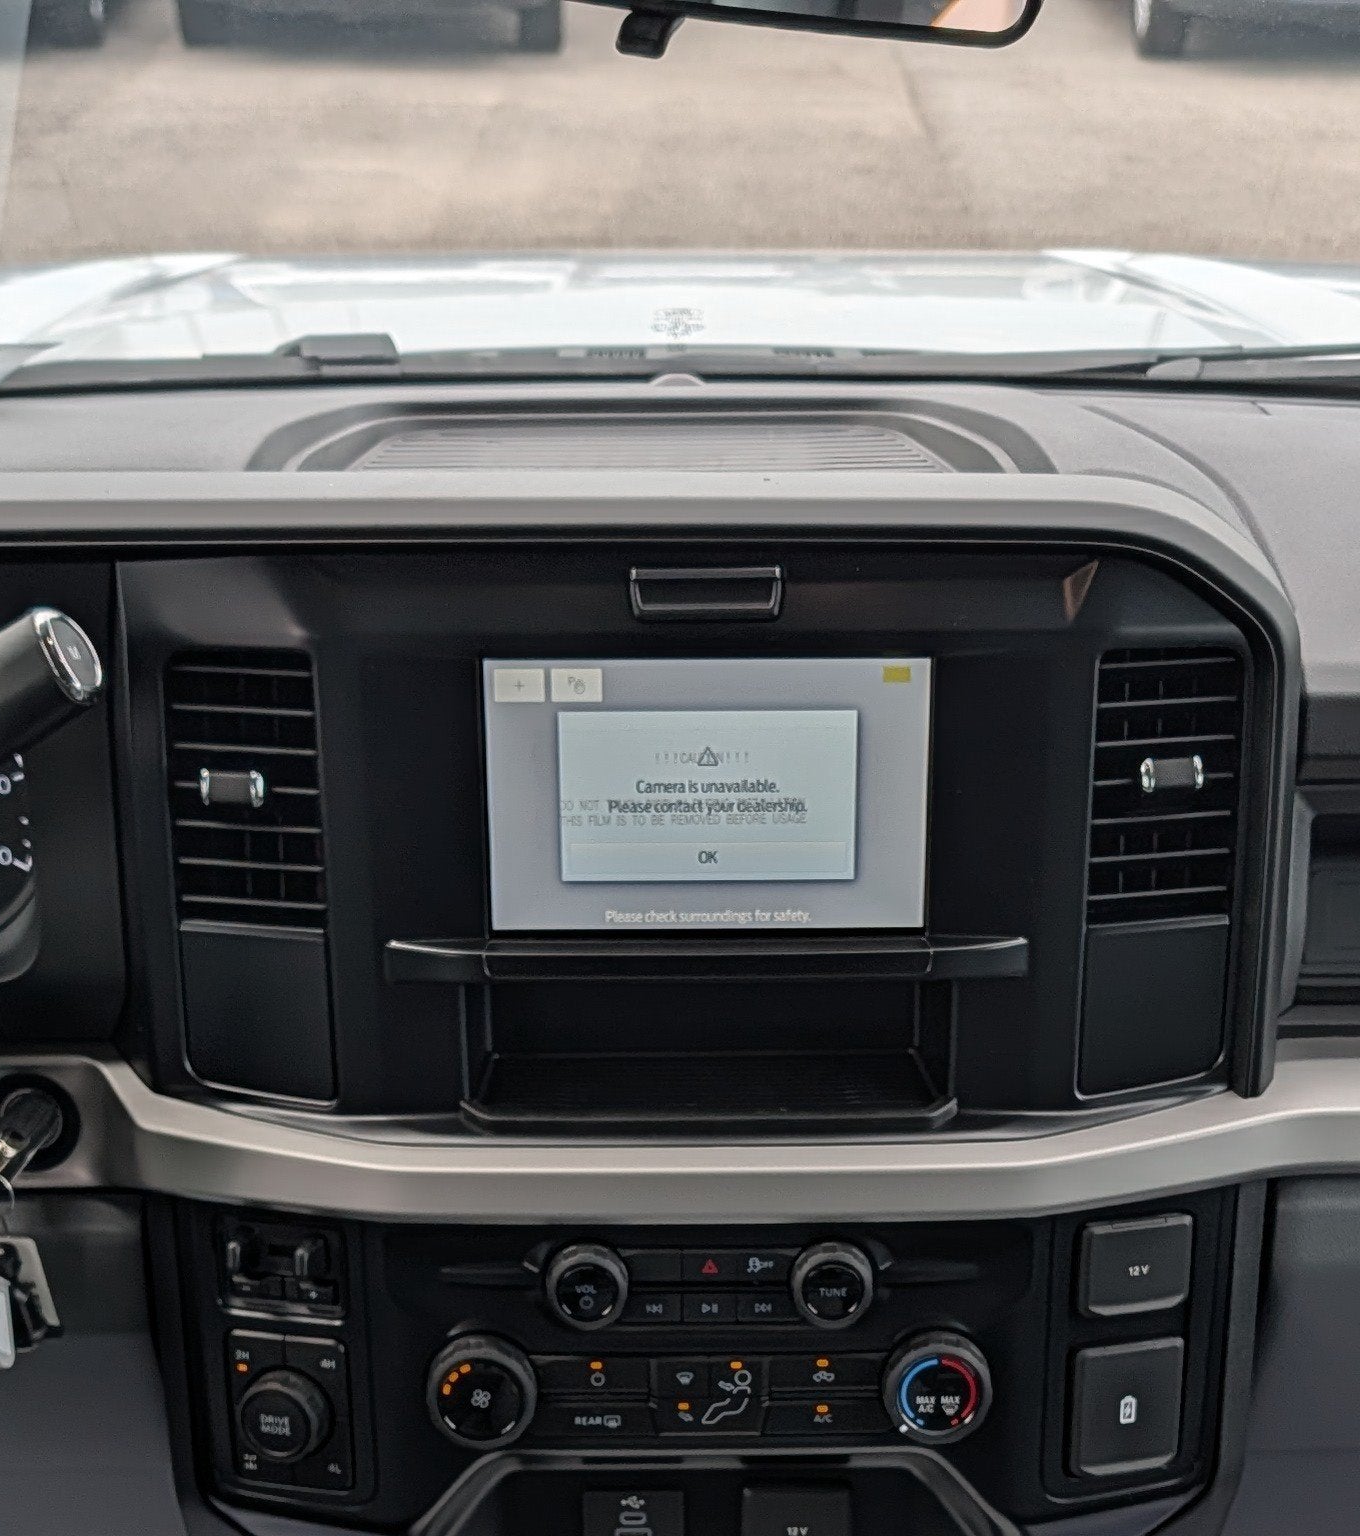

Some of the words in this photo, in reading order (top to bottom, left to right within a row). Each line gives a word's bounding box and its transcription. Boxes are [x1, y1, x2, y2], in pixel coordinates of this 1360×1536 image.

[635, 780, 686, 795] Camera
[688, 780, 699, 795] is
[701, 779, 780, 795] unavailable.
[607, 800, 652, 814] Please
[653, 800, 703, 814] contact
[706, 801, 735, 816] your
[737, 800, 808, 816] dealership.
[589, 815, 612, 827] FILM
[632, 815, 647, 826] TO
[650, 814, 665, 826] BE
[671, 814, 721, 826] REMOVED
[726, 813, 767, 825] BEFORE
[772, 813, 807, 825] USAGE
[697, 850, 718, 864] OK
[604, 910, 643, 923] Please
[645, 910, 677, 923] check
[679, 910, 752, 925] surroundings
[754, 909, 770, 922] for
[773, 909, 812, 924] safety.
[818, 1286, 847, 1298] TUNE
[915, 1395, 936, 1405] MAX
[940, 1395, 961, 1405] MAX
[917, 1404, 935, 1414] A/C
[259, 1413, 290, 1424] DRIVE
[574, 1416, 602, 1426] REAR
[813, 1414, 833, 1424] A/C
